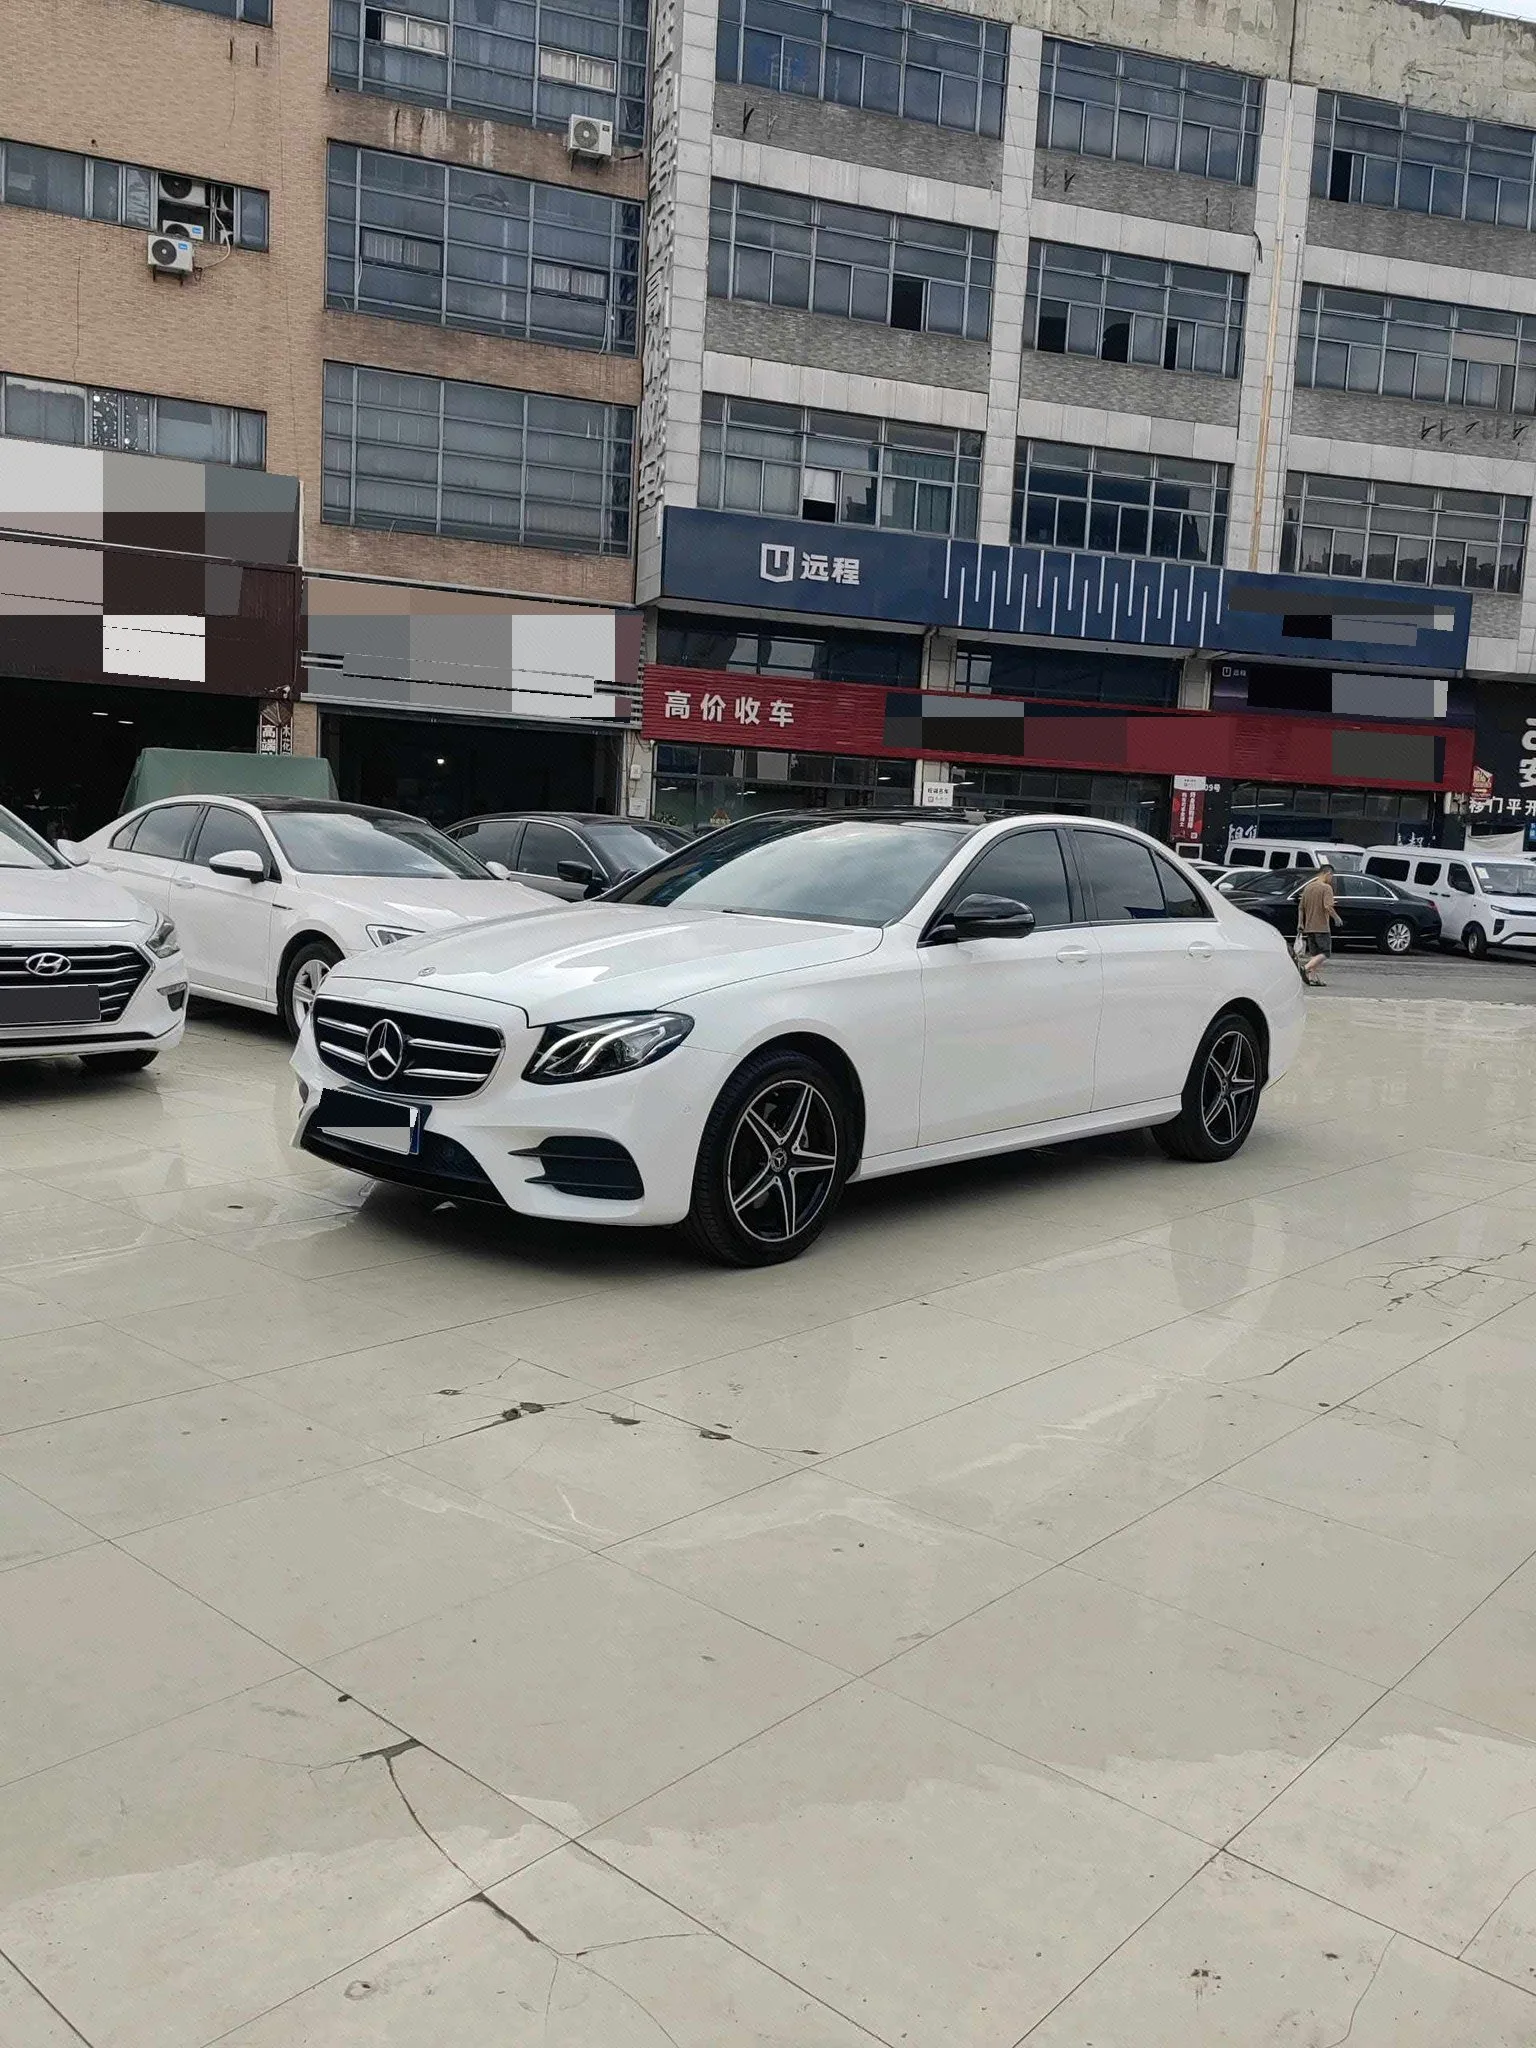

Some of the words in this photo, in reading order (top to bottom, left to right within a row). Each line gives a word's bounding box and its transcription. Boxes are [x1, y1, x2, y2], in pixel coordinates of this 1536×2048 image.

[800, 551, 860, 585] 远程
[664, 690, 795, 728] 高价收车
[261, 724, 277, 755] 高端
